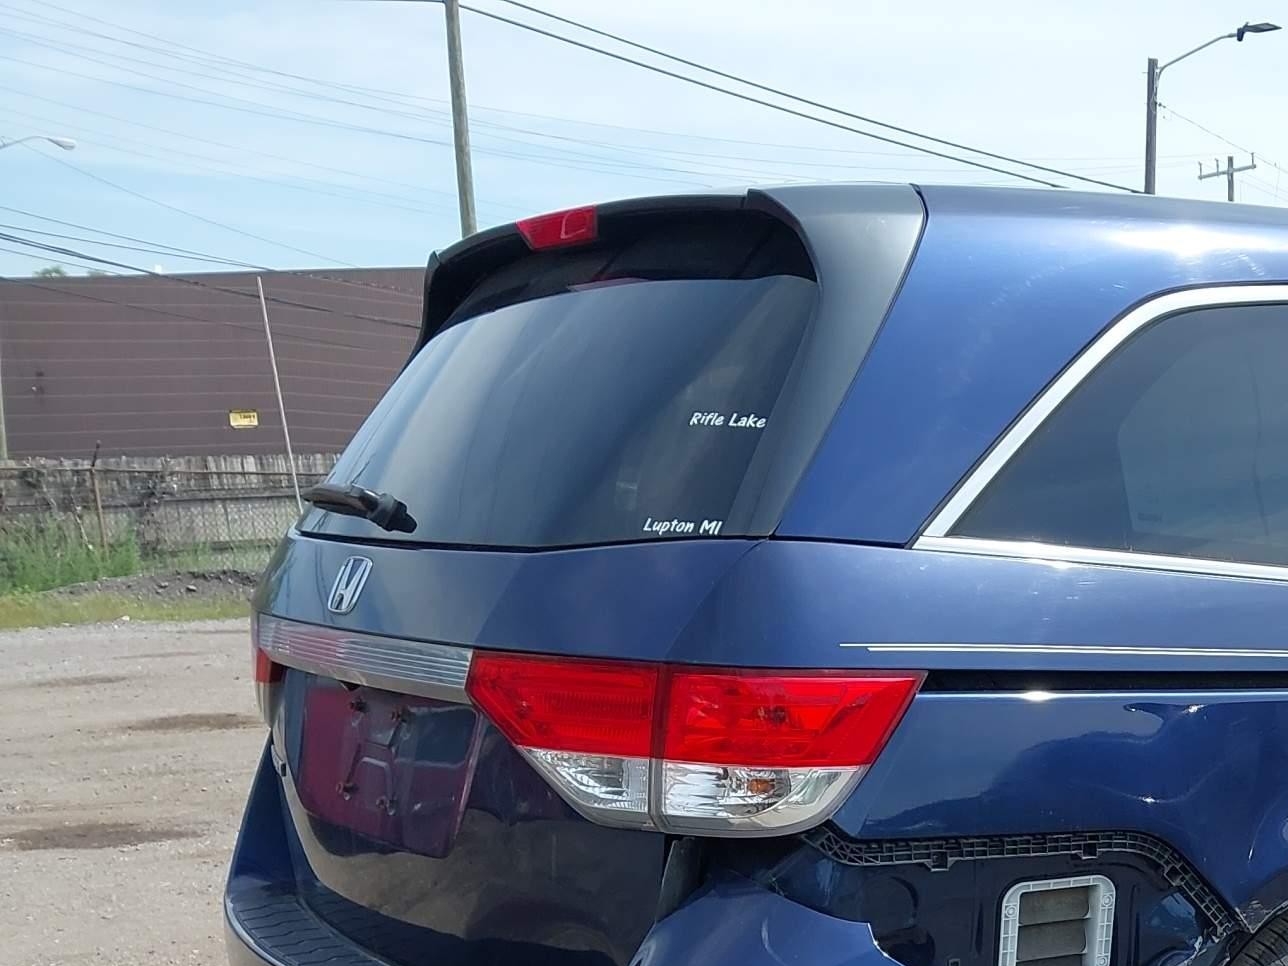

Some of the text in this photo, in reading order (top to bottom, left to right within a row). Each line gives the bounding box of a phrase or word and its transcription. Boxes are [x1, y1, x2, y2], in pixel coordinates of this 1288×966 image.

[689, 412, 768, 429] Rifle Lake
[642, 517, 723, 536] Lupton MI
